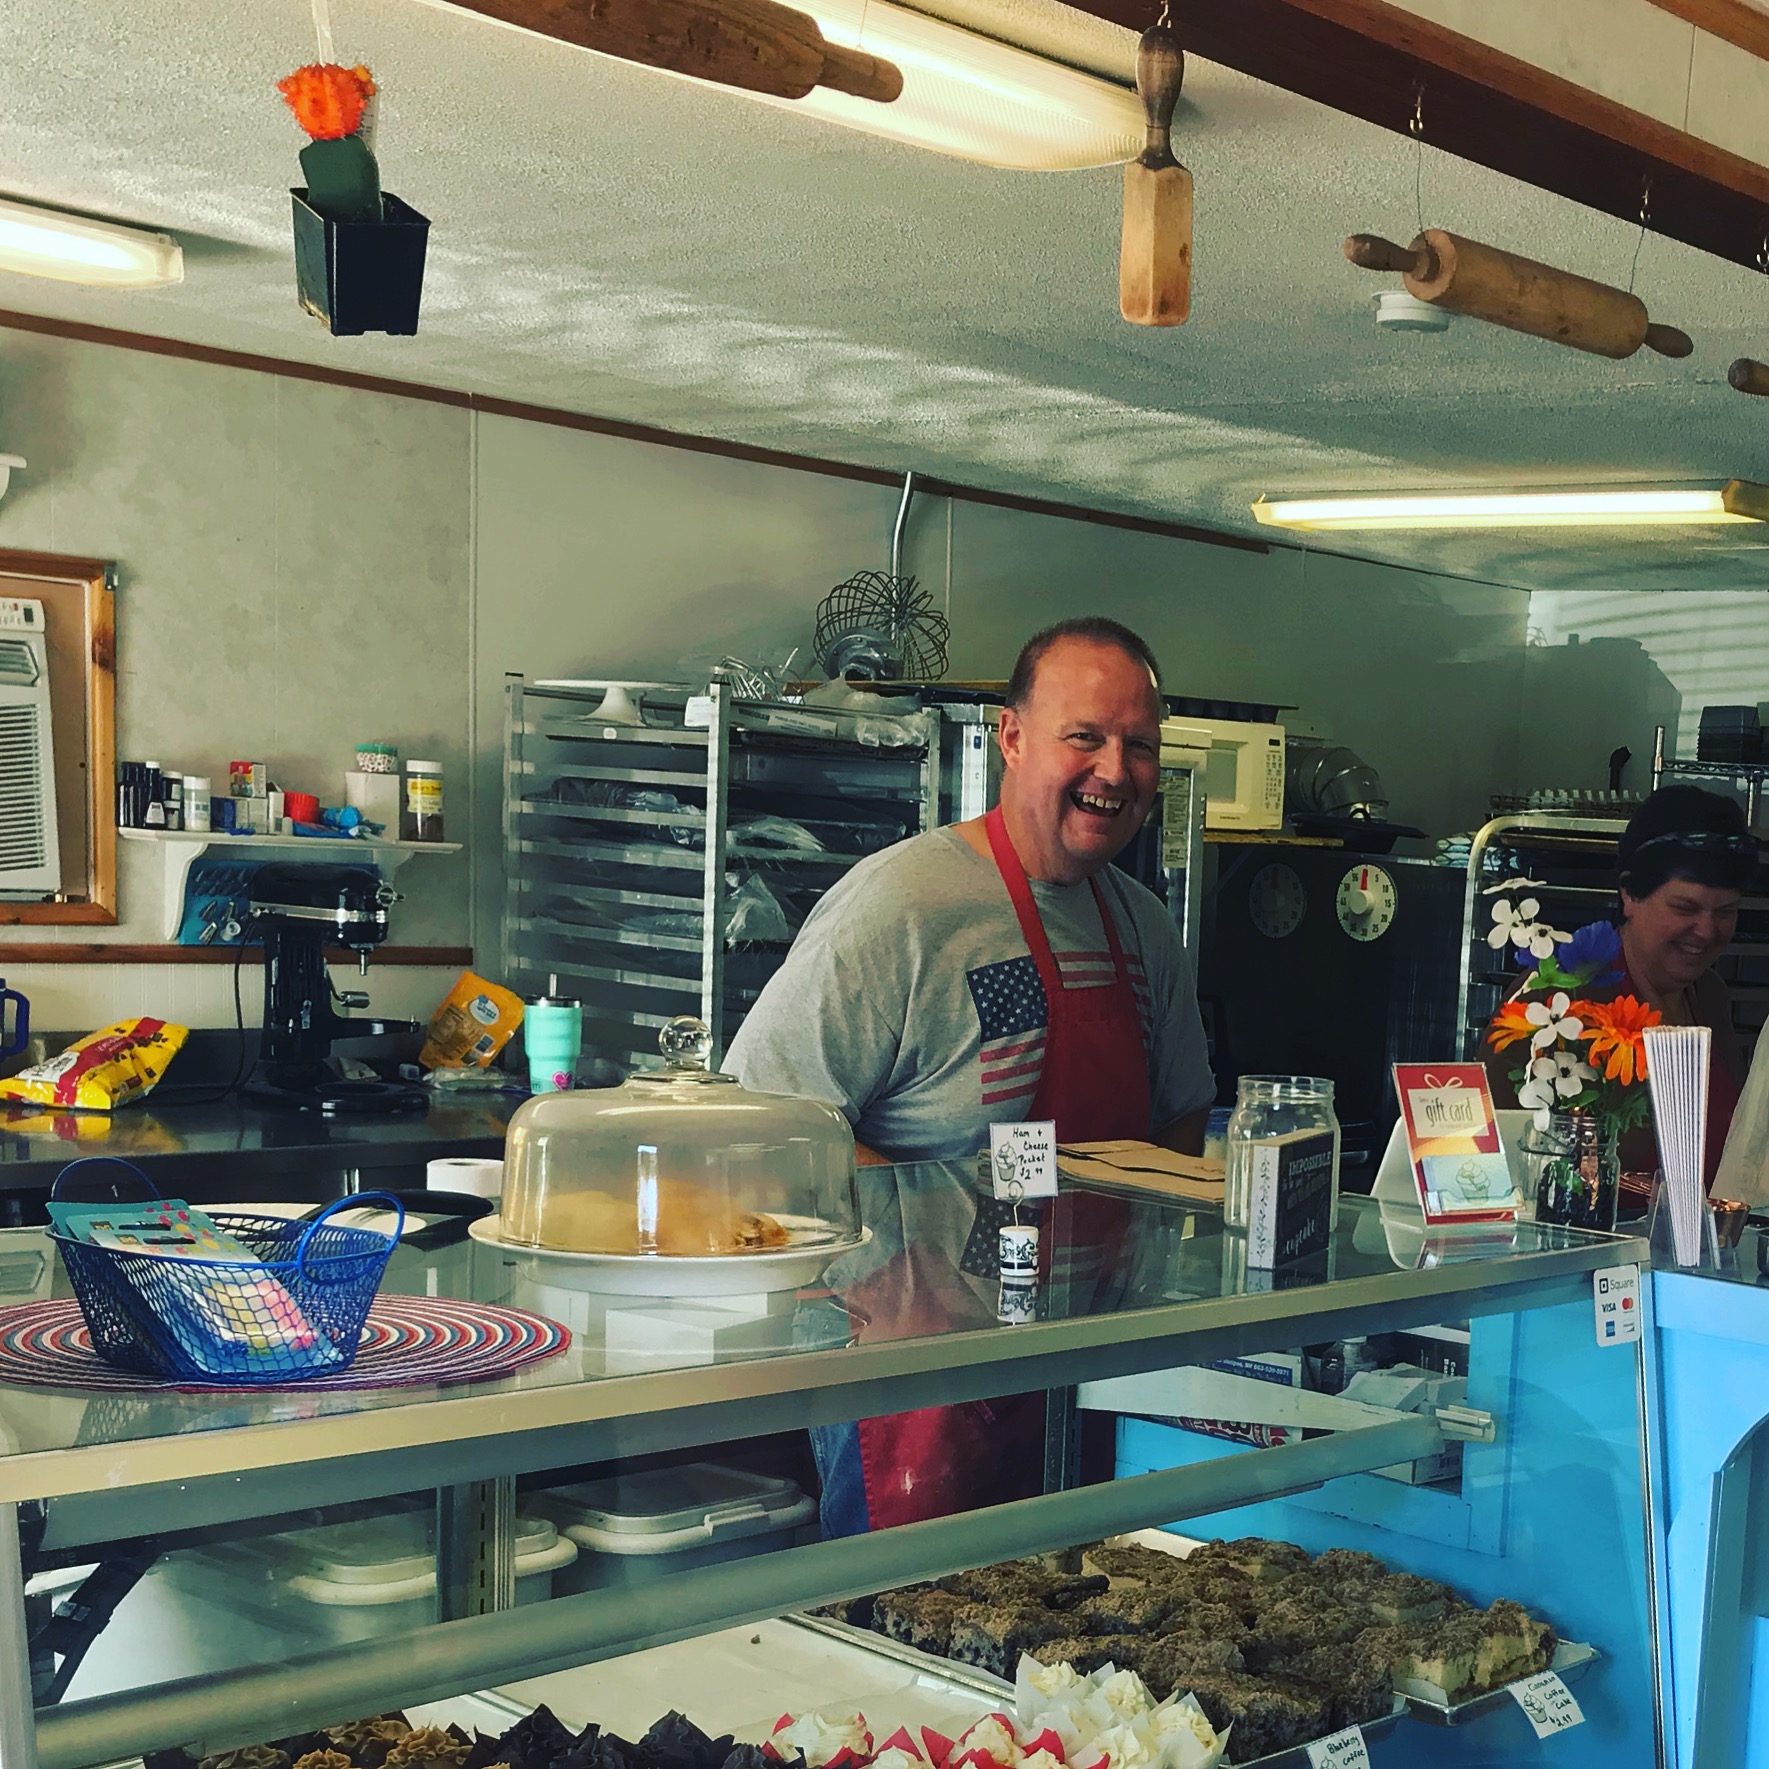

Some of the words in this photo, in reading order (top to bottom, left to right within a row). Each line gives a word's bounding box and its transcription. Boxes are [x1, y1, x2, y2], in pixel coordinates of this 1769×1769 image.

[1375, 874, 1379, 883] 5
[1383, 884, 1389, 893] 10
[1385, 899, 1391, 908] 15
[1381, 914, 1388, 922] 20
[1372, 924, 1379, 933] 25
[1425, 1096, 1447, 1128] gift
[1449, 1097, 1473, 1122] card
[1012, 1127, 1030, 1138] Ham
[1023, 1140, 1049, 1151] Cheese
[1017, 1152, 1046, 1166] Pocket
[1610, 1278, 1635, 1292] Square
[1601, 1302, 1617, 1313] VISA
[1326, 1736, 1361, 1754] Blueberry
